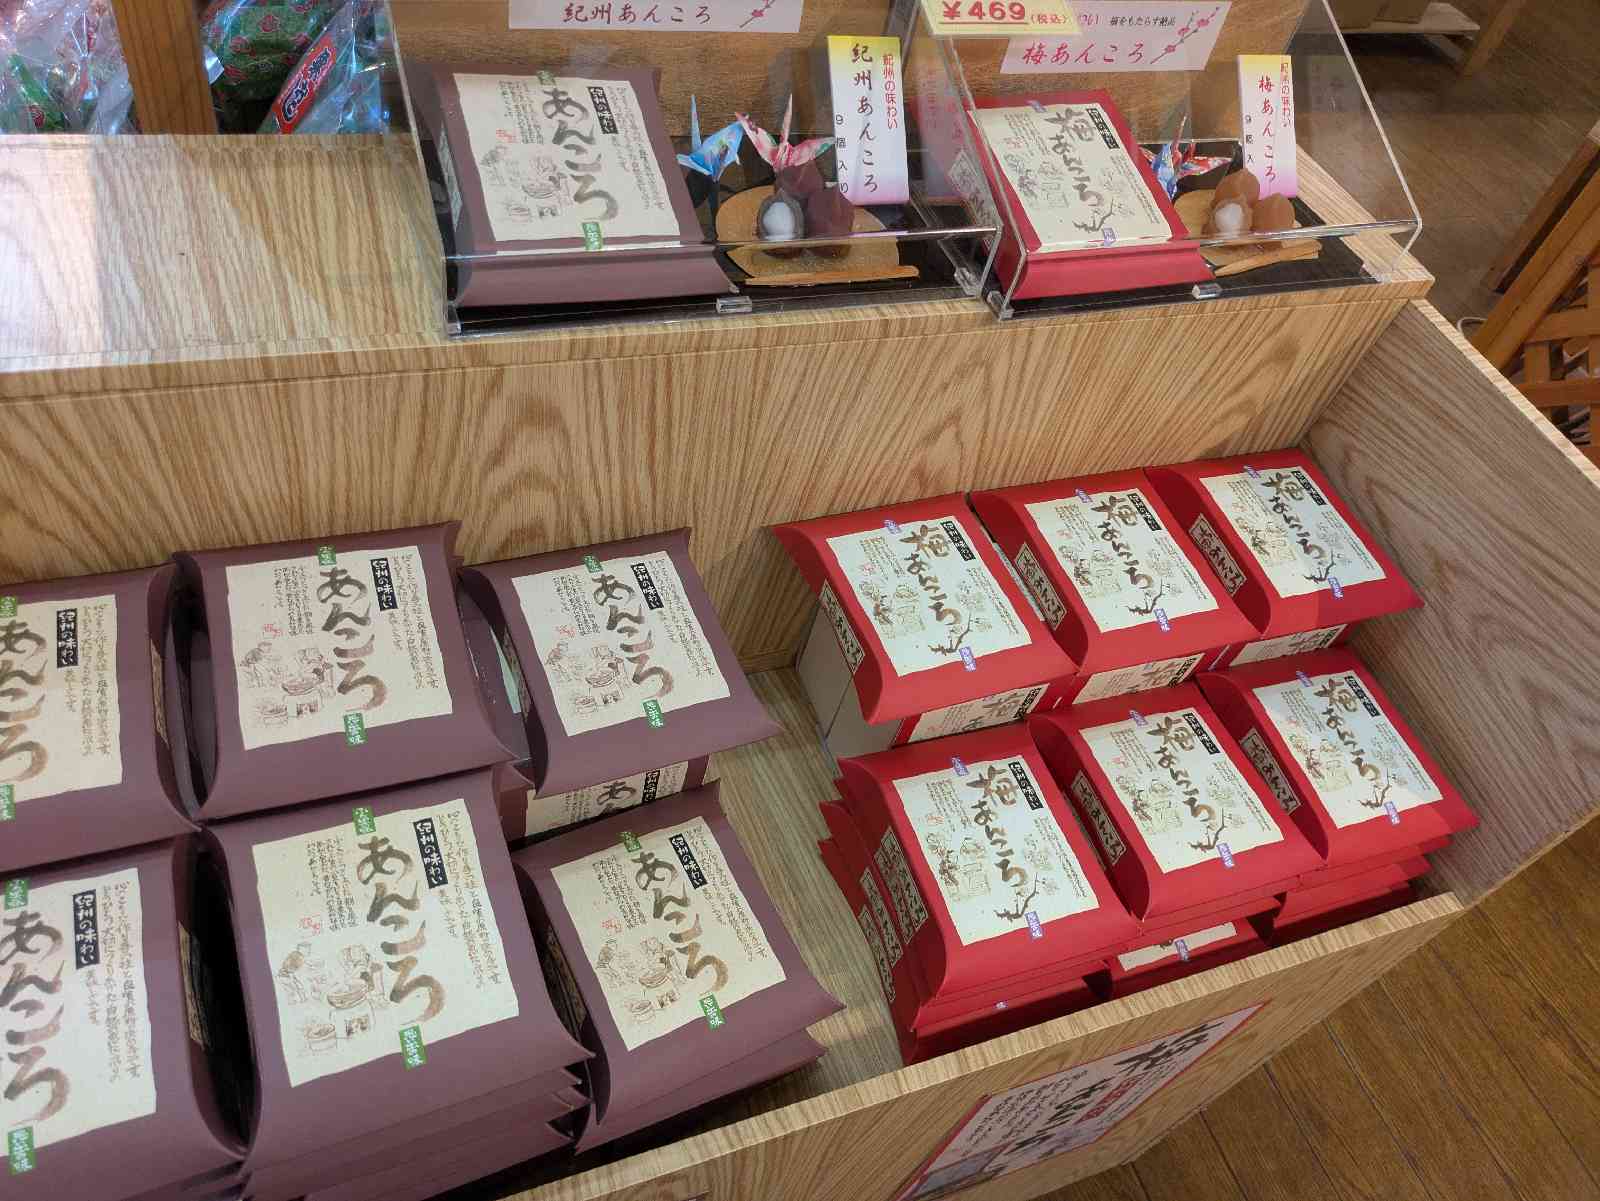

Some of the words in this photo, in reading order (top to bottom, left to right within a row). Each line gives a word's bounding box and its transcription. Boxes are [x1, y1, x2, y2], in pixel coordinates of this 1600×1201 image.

[562, 2, 712, 25] 紀州あんころ
[1023, 42, 1145, 65] 梅あんころ
[542, 87, 619, 221] あんころ
[851, 43, 878, 193] 紀州あんころ
[882, 54, 898, 130] 紀州の味わい
[1257, 74, 1276, 183] 梅あんころ
[592, 574, 674, 700] あんころ
[901, 525, 961, 625] 梅あんころ
[317, 566, 387, 713] あんころ
[966, 765, 1028, 888] 梅あんころ
[74, 890, 99, 967] 紀州の味わい
[356, 836, 447, 1026] あんころ
[632, 851, 728, 998] あんころ
[0, 910, 70, 1127] あんころ
